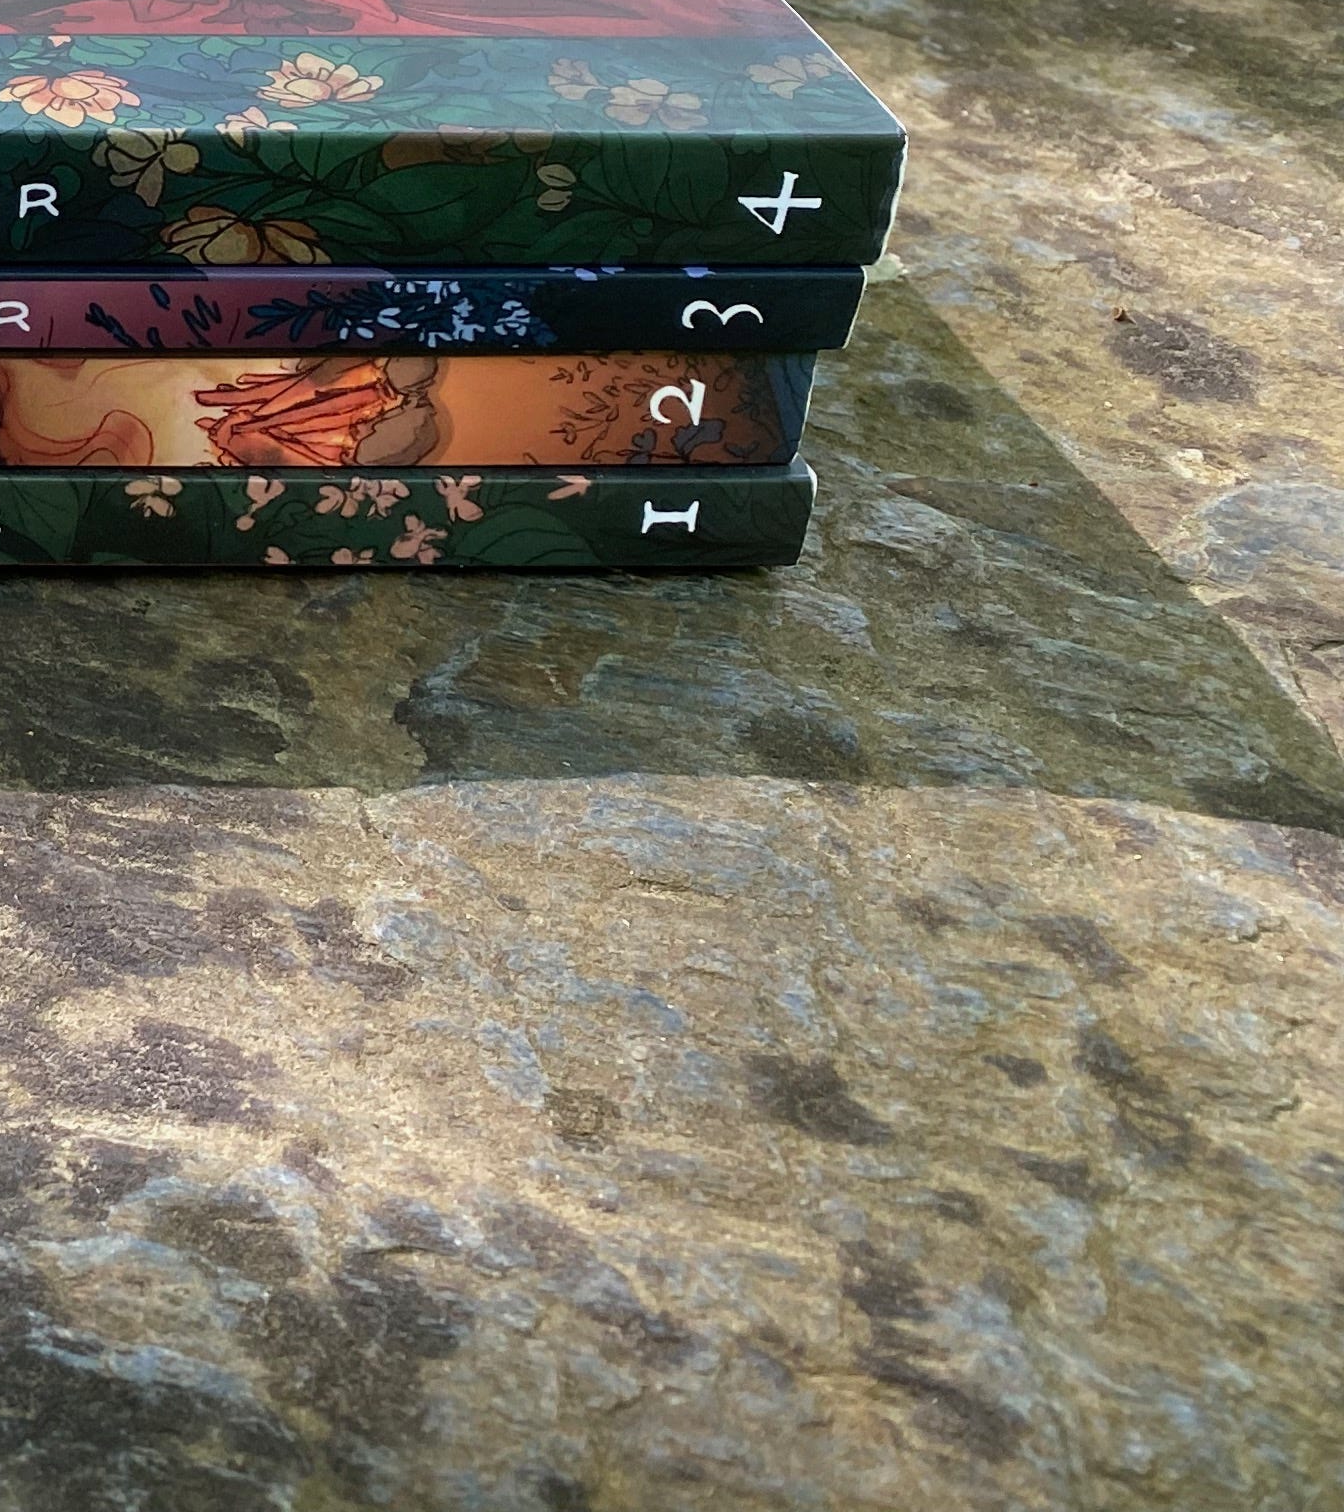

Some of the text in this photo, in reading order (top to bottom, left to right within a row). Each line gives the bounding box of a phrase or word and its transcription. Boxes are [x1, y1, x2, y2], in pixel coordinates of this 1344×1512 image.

[737, 171, 823, 235] 4
[680, 299, 765, 330] 3
[649, 378, 707, 427] 2
